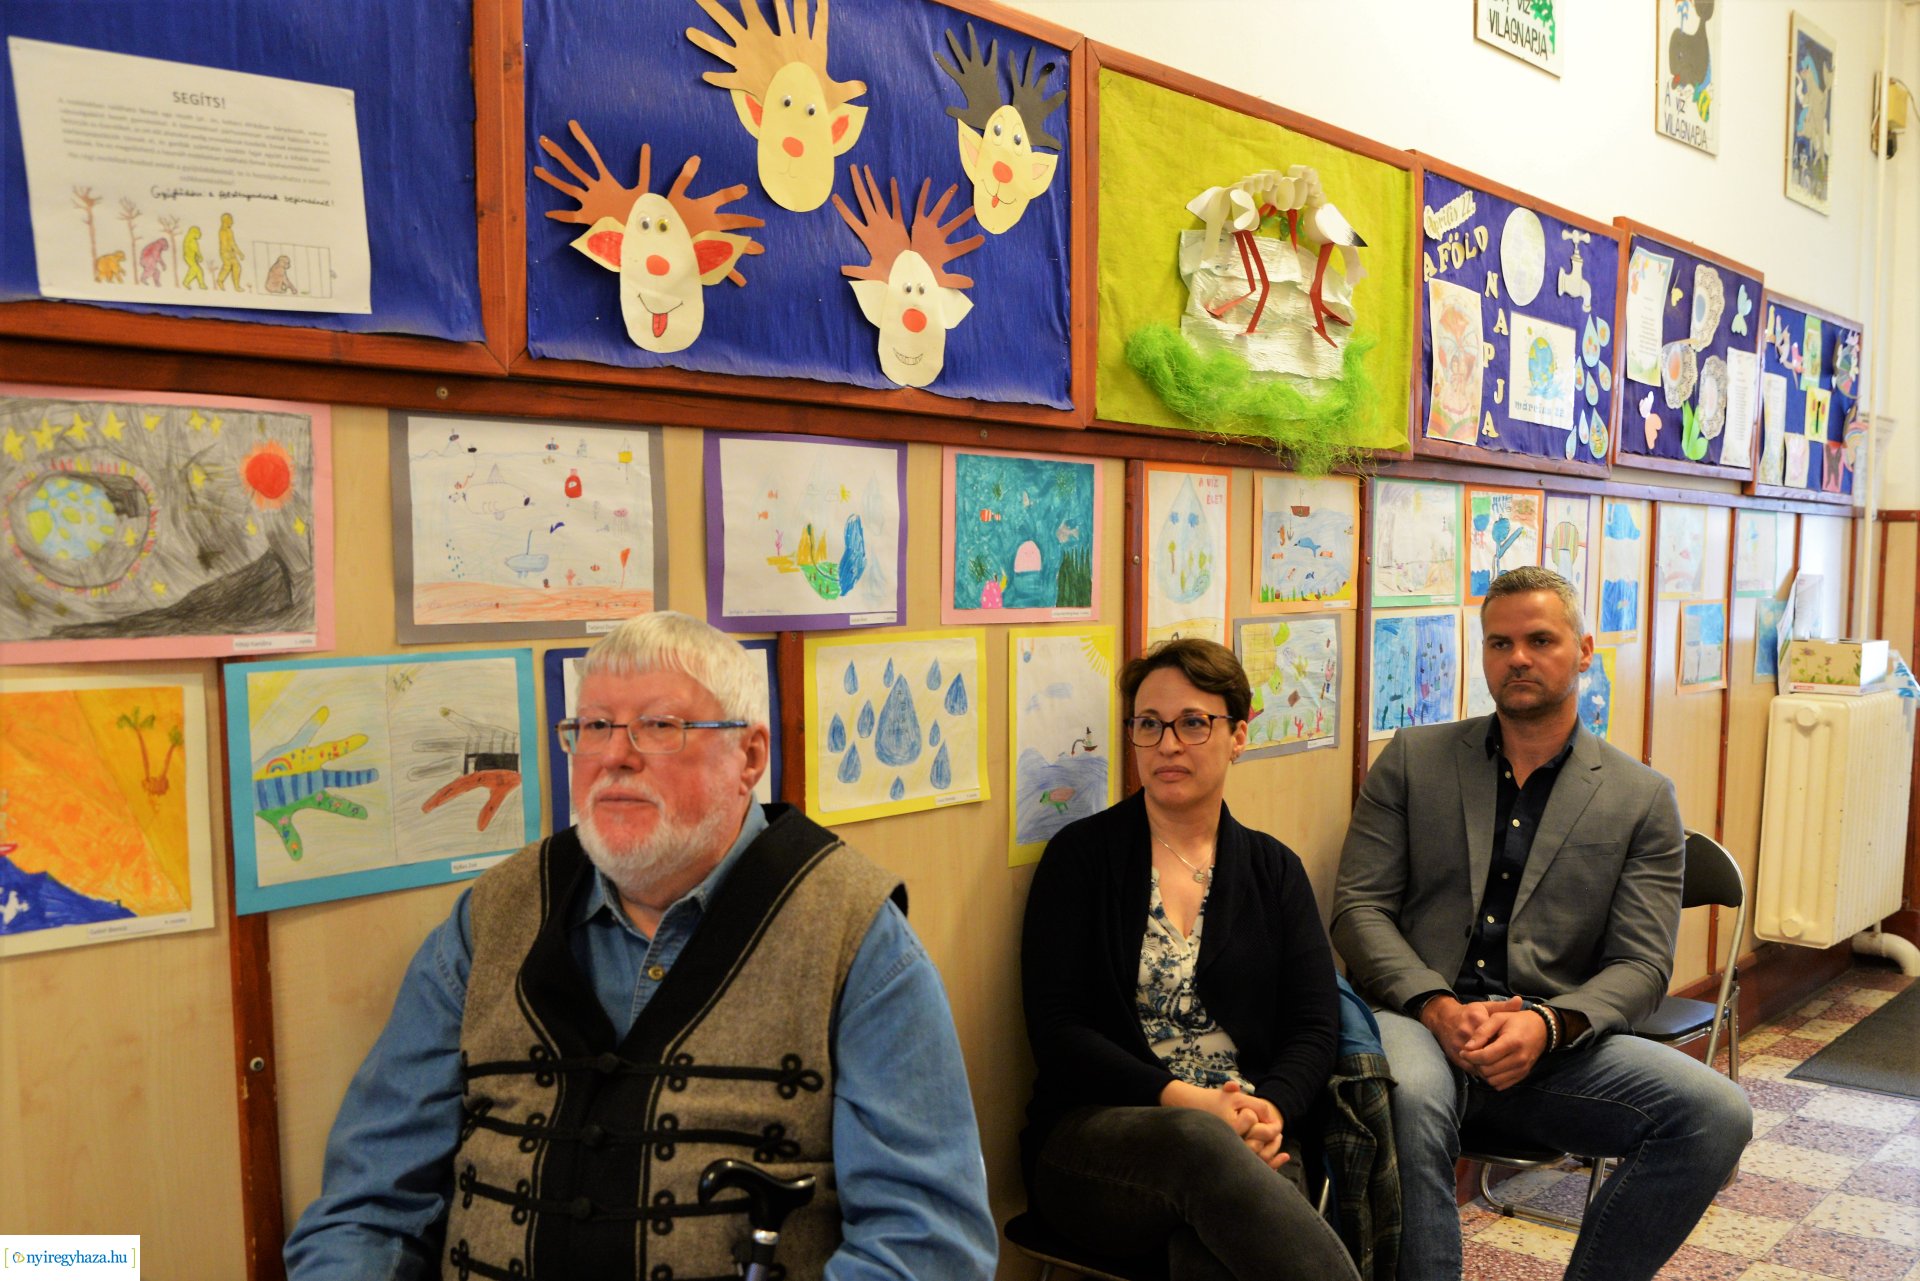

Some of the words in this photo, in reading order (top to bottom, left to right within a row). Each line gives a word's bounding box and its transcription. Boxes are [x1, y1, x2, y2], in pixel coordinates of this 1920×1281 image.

[172, 90, 226, 109] SEGÍTS!
[1424, 252, 1438, 282] A
[1437, 225, 1488, 273] FÖLD
